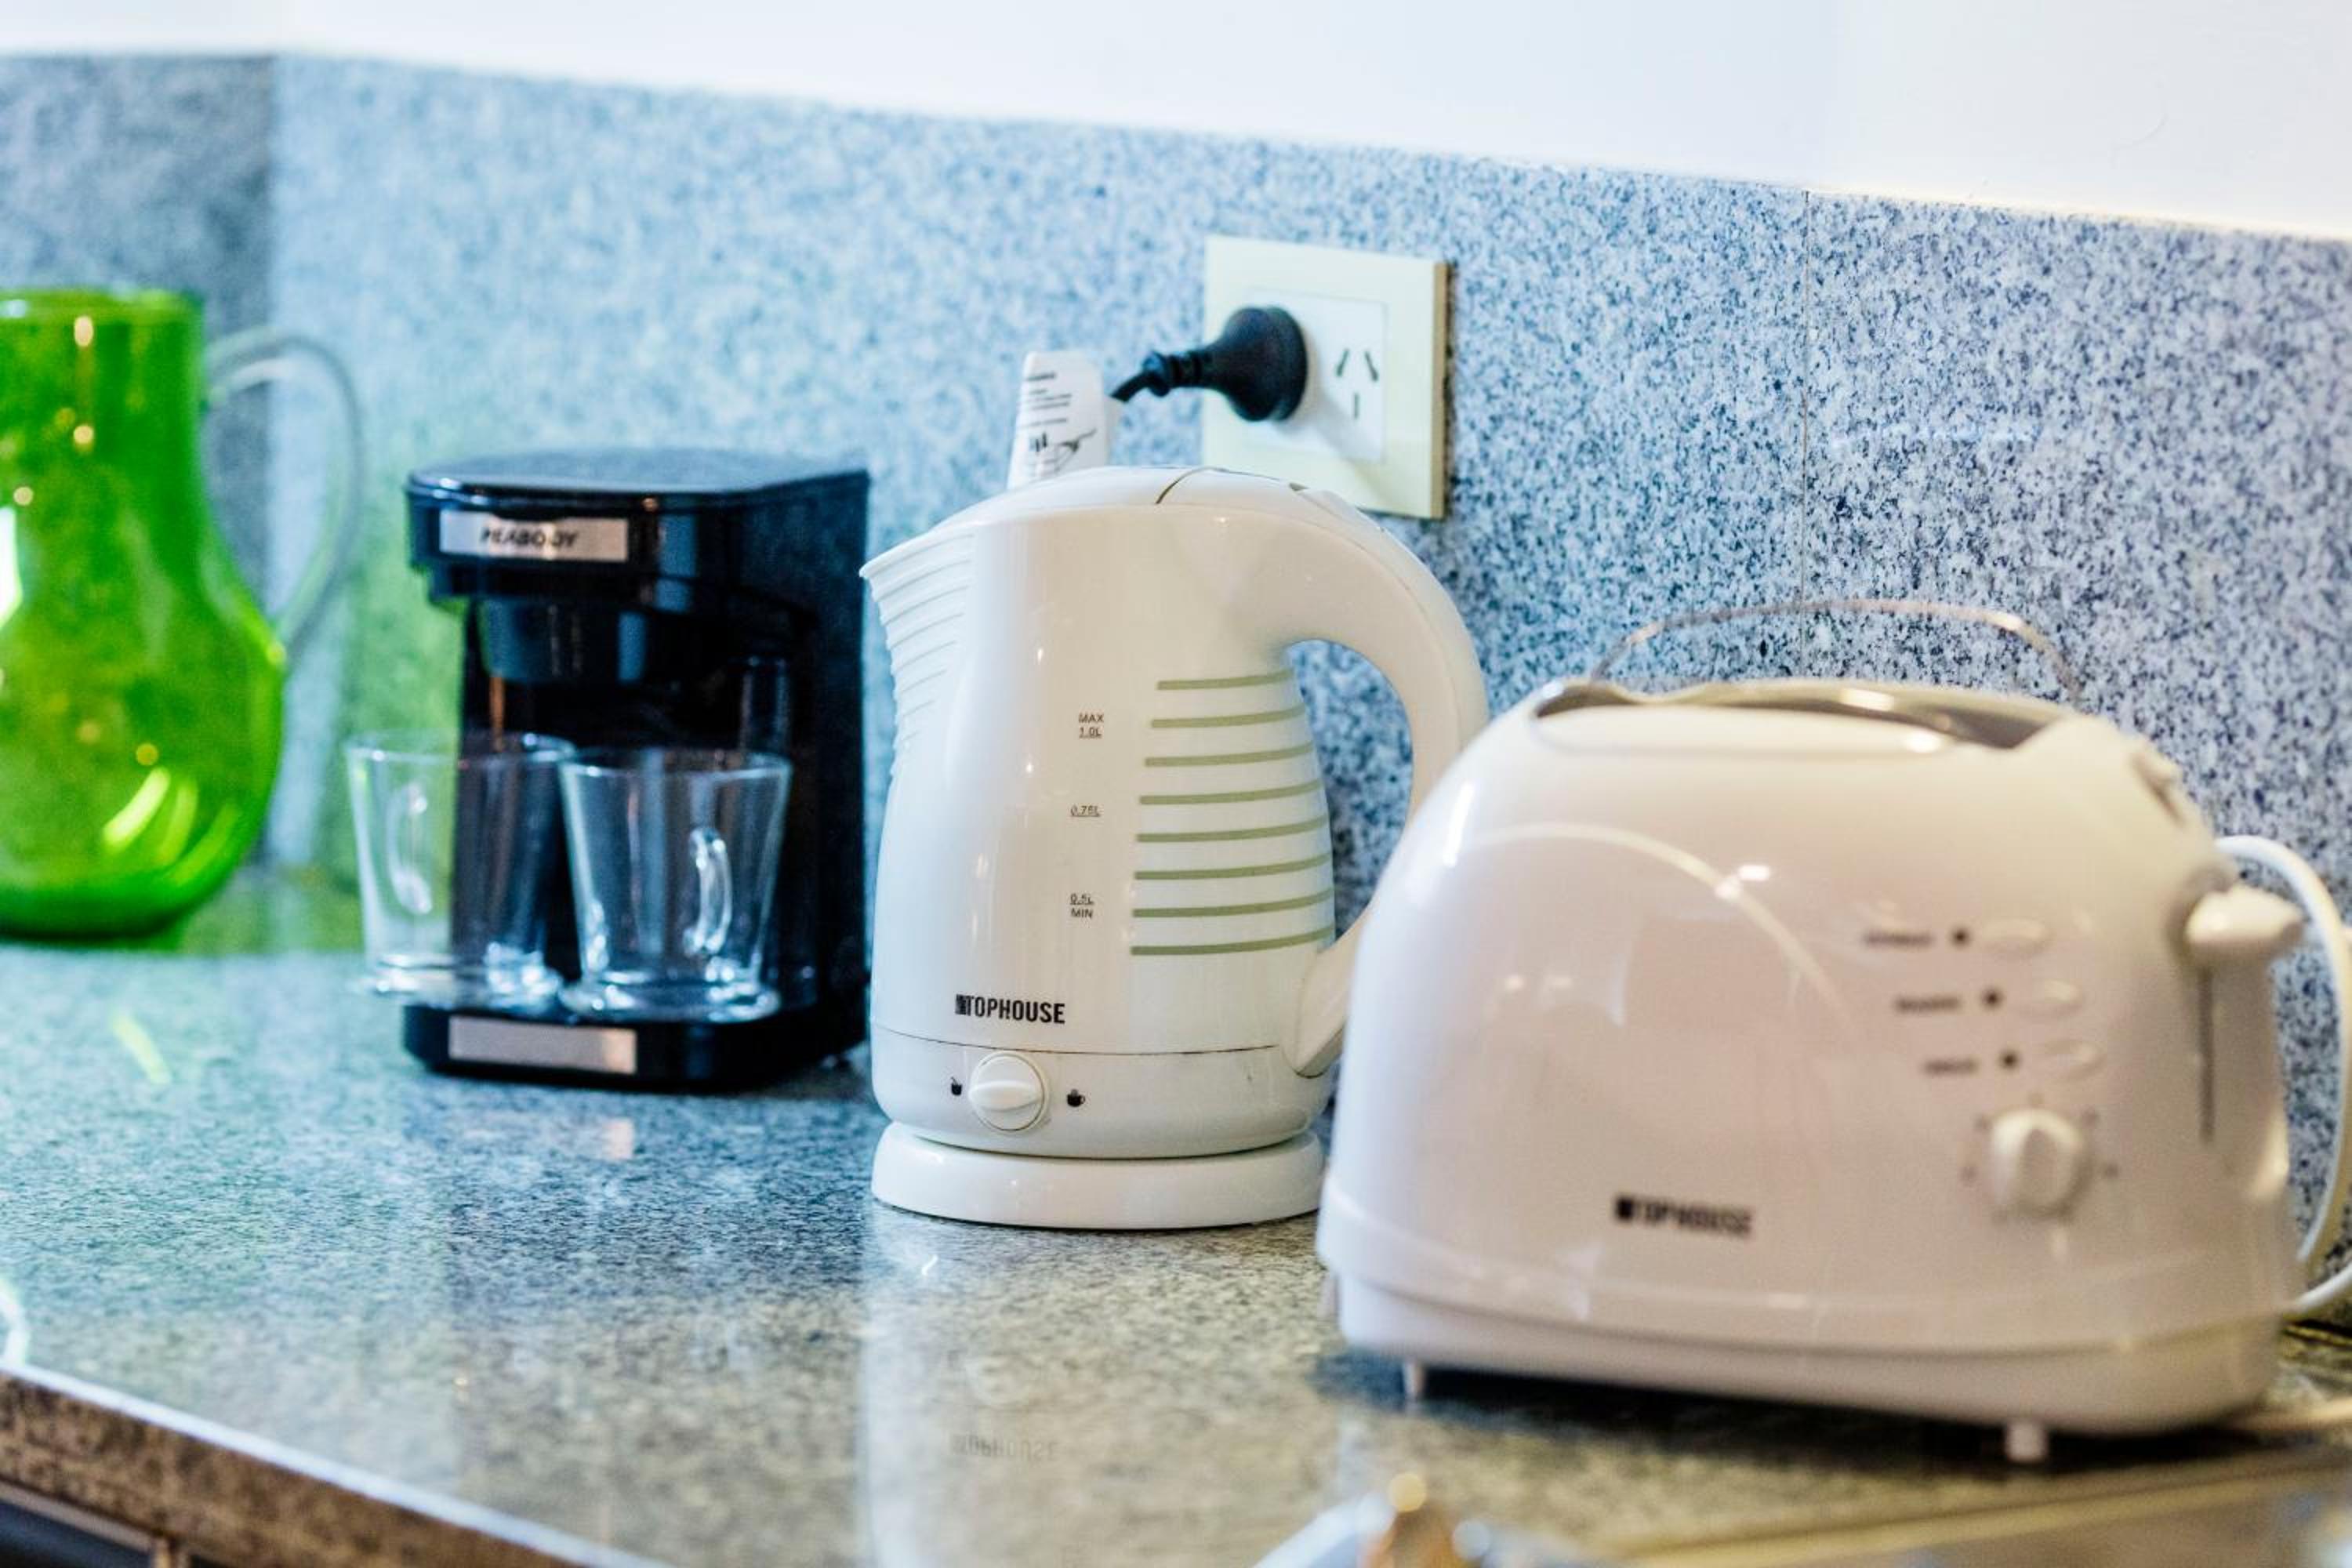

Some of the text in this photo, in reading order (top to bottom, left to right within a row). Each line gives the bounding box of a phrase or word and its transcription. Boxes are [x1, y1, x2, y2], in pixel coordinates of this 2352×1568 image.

[479, 526, 579, 546] PEABODY
[1079, 713, 1104, 723] MAX
[1079, 727, 1102, 738] 1.0L
[1070, 804, 1100, 817] 0.75L
[1070, 893, 1094, 906] 0.5L
[1071, 908, 1093, 919] MIN
[956, 994, 1065, 1024] TOPHOUSE
